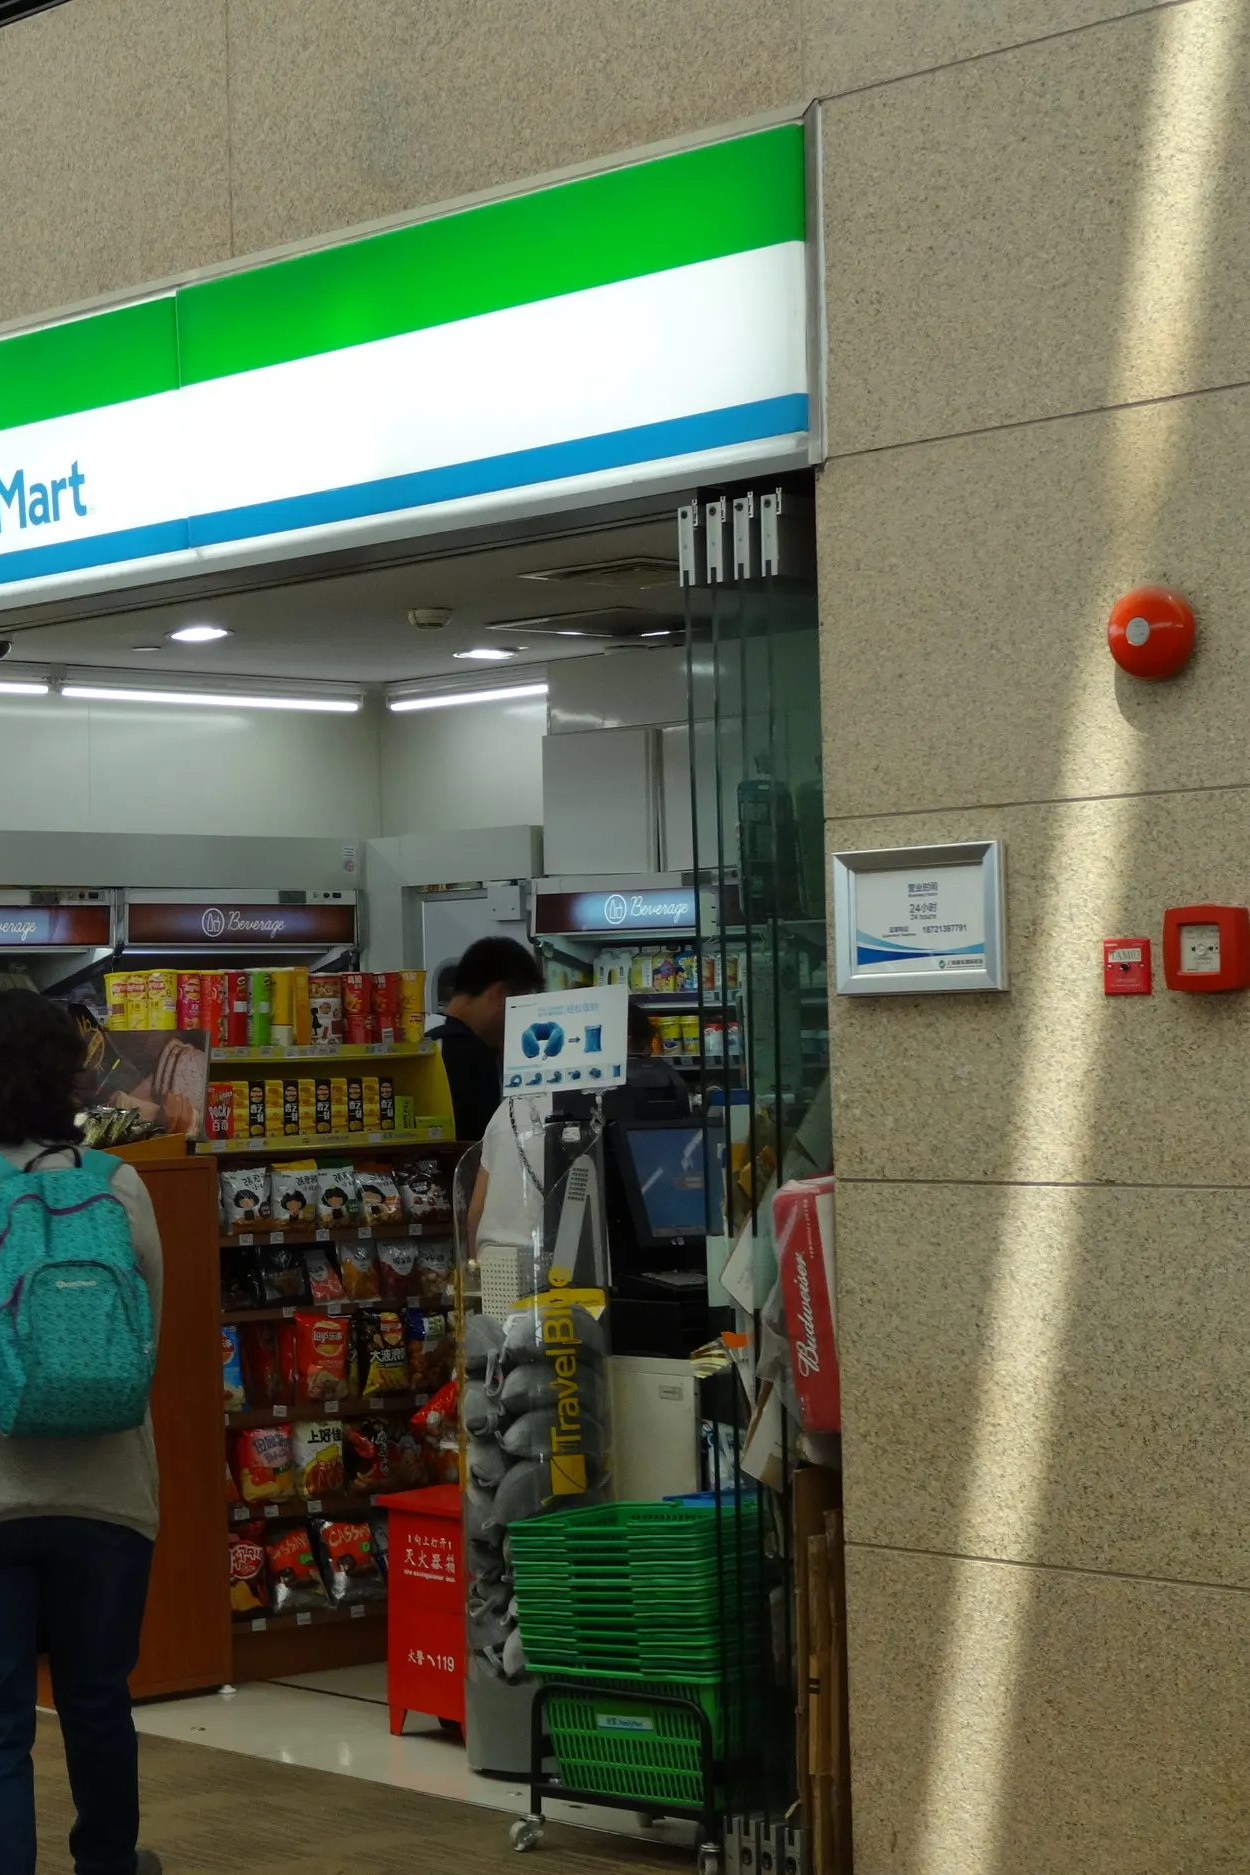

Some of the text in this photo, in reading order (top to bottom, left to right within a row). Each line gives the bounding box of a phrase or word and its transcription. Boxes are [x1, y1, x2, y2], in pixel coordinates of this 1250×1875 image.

[630, 895, 690, 923] Beverage
[227, 910, 286, 939] Beverage
[797, 1252, 821, 1378] Budweiser
[403, 1548, 456, 1575] 灭火器箱
[436, 1654, 455, 1672] 119
